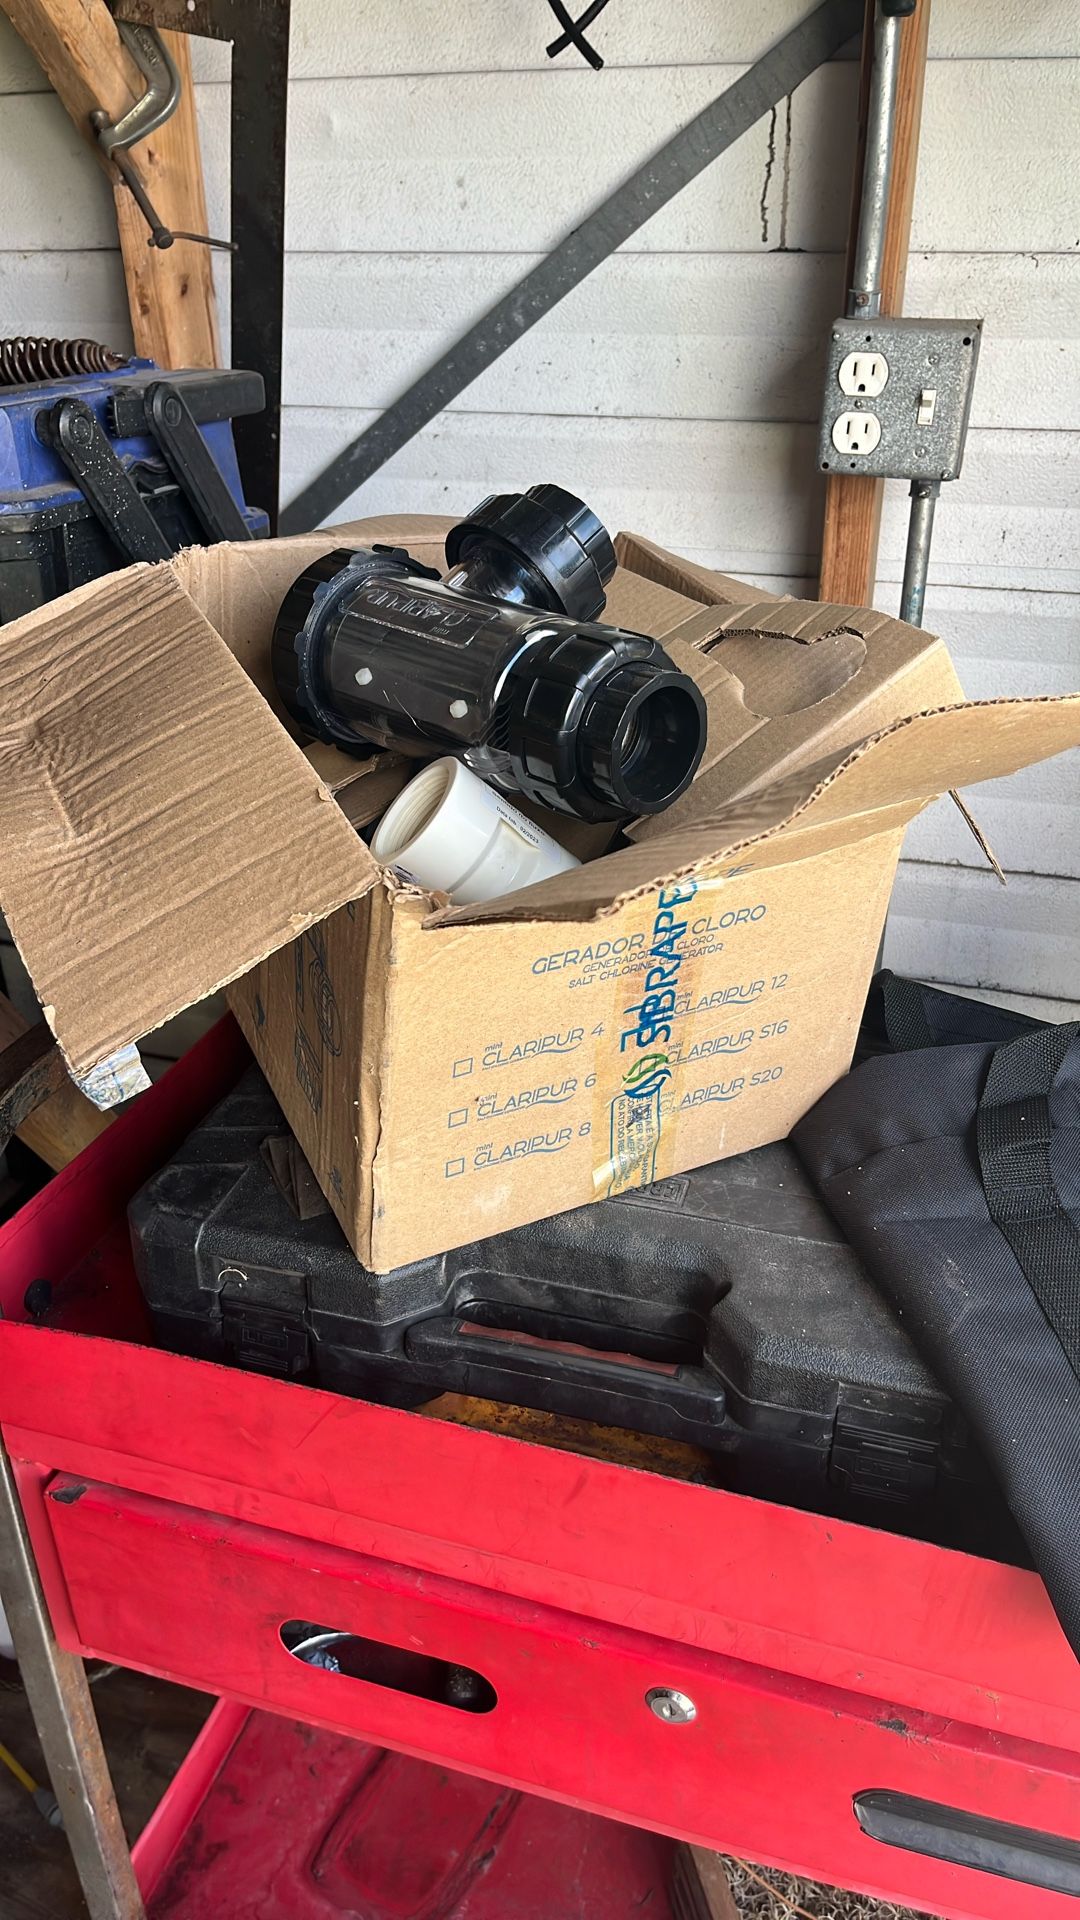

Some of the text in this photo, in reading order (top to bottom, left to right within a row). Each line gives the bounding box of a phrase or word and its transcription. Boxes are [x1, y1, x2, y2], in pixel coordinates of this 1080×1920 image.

[366, 588, 471, 627] CLARIPUR
[531, 932, 646, 976] GERADOR
[691, 904, 767, 936] CLORO
[582, 948, 653, 974] GENERADOR
[676, 933, 715, 951] CLORO
[568, 942, 724, 989] SALT CHLORINE GEERATOR
[673, 980, 766, 1015] CLARIPUR
[771, 973, 789, 990] 12
[482, 1027, 585, 1066] CLARIPUR
[591, 1021, 605, 1036] 4
[666, 1029, 755, 1065] CLARIPUR
[760, 1019, 790, 1039] S16
[477, 1078, 578, 1117] CLARIPUR
[584, 1073, 598, 1088] 6
[749, 1066, 783, 1086] S20
[473, 1127, 573, 1166] CLARIPUR
[578, 1121, 592, 1137] 8
